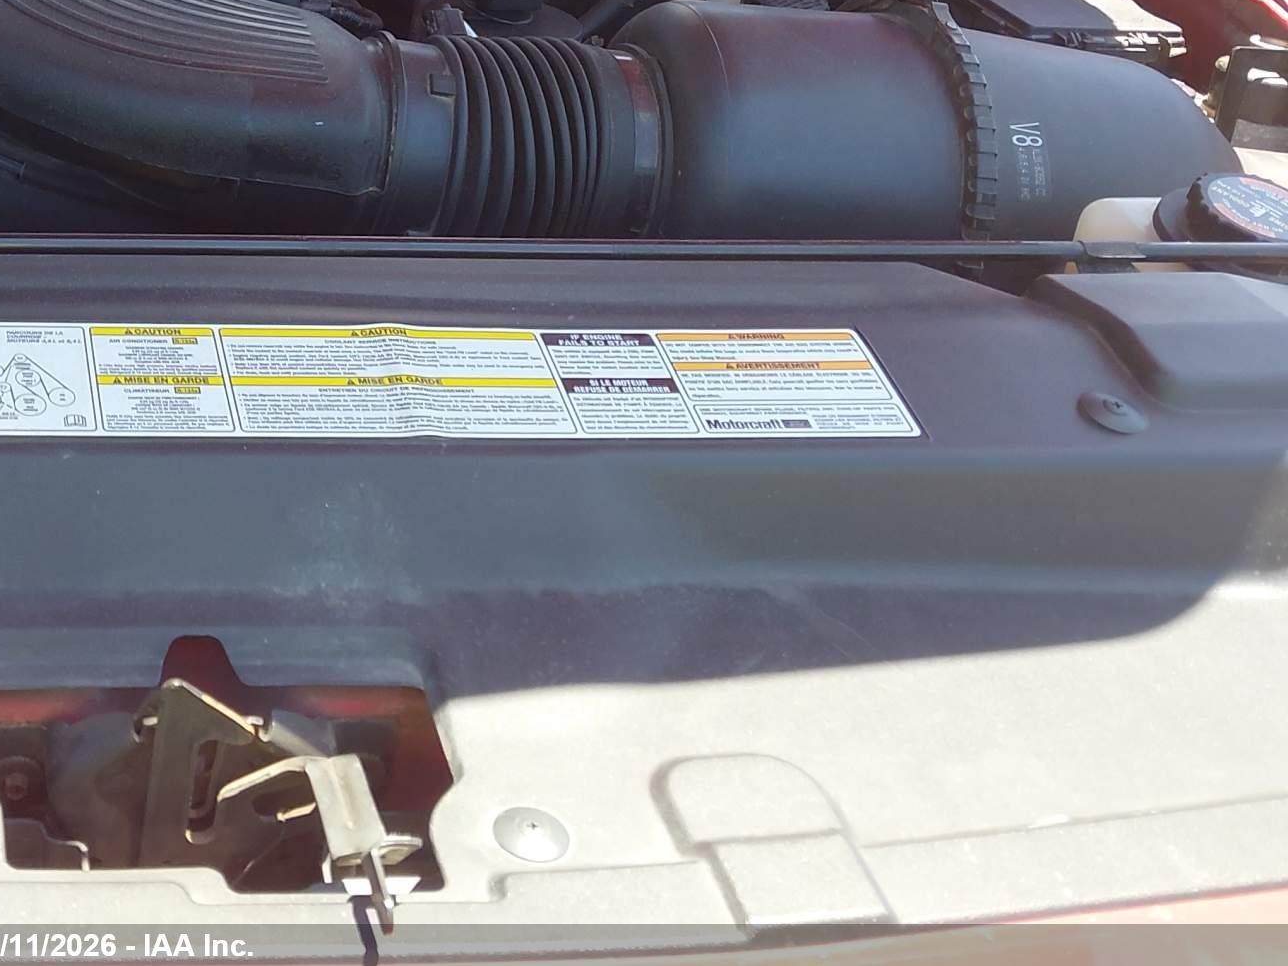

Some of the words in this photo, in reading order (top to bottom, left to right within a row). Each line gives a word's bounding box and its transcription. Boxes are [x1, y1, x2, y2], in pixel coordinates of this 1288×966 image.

[1009, 122, 1043, 146] V8
[360, 328, 407, 336] CAUTION
[388, 376, 403, 384] EN
[406, 376, 442, 385] GARDE
[706, 419, 782, 430] Motorcraft
